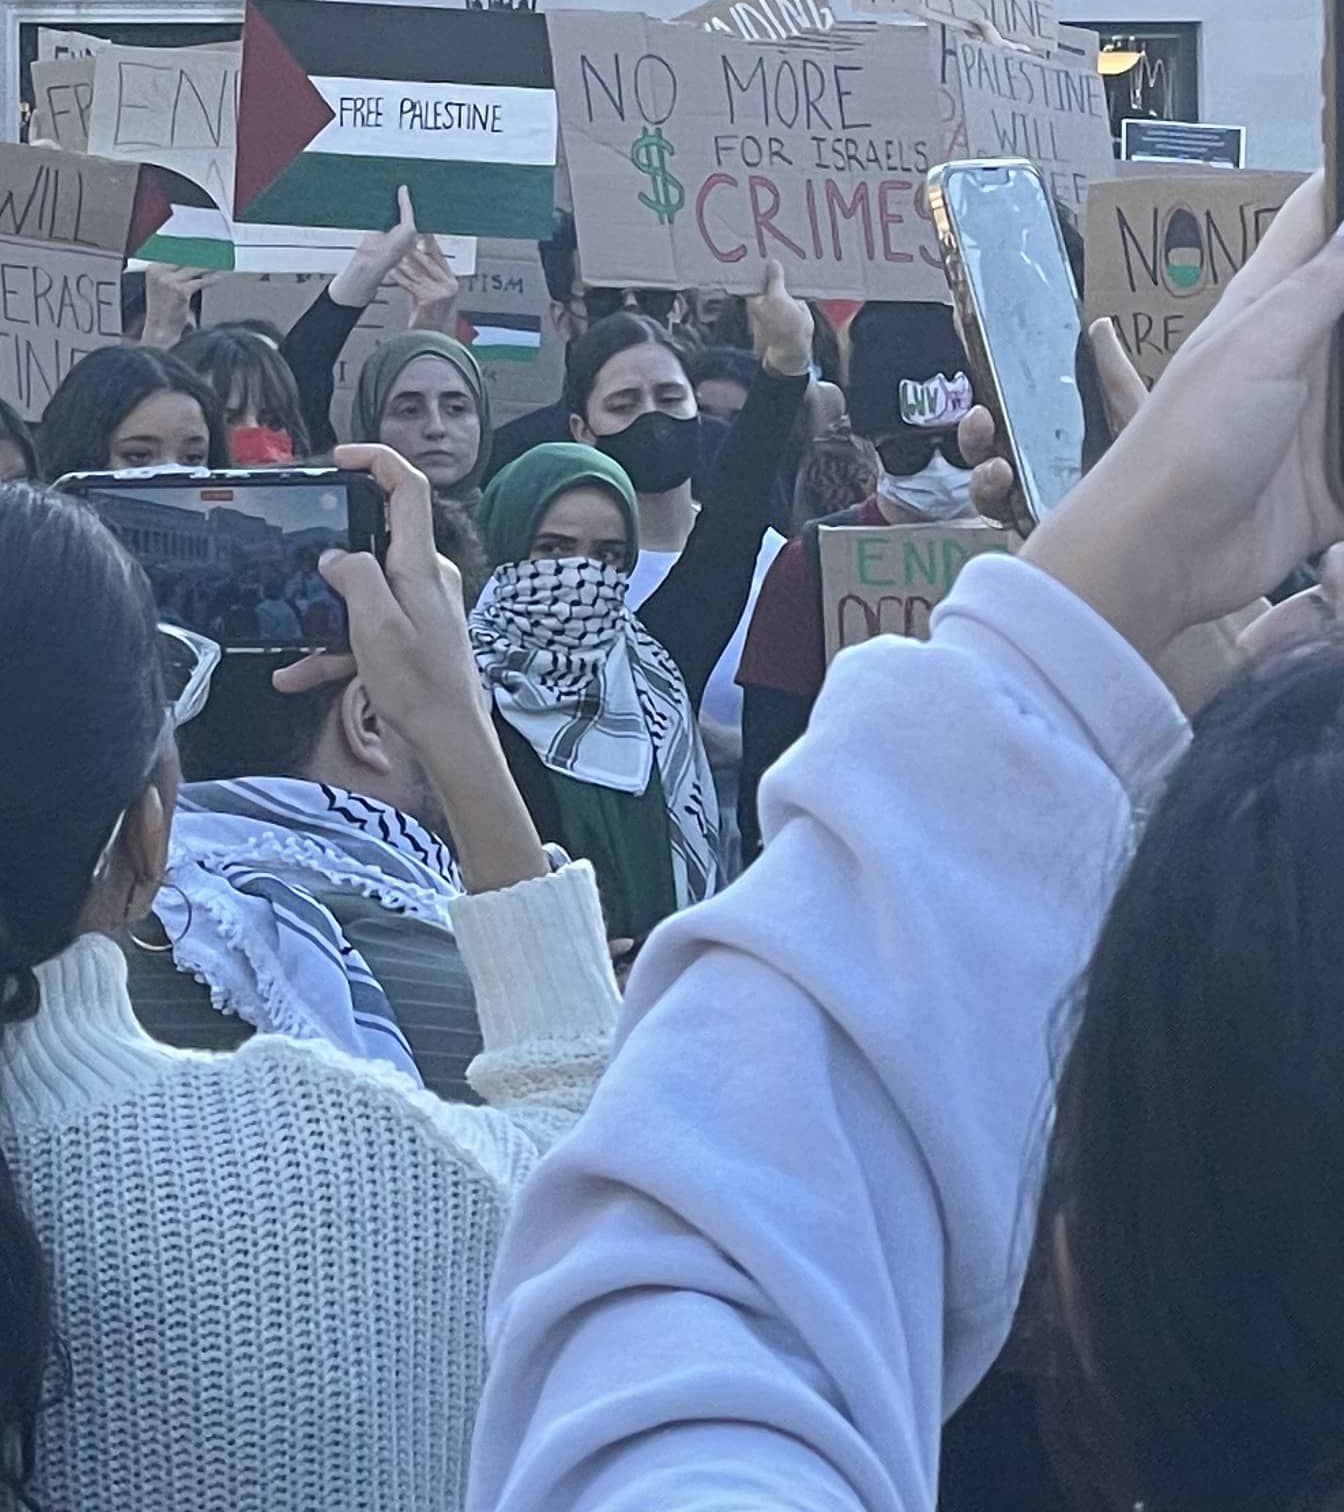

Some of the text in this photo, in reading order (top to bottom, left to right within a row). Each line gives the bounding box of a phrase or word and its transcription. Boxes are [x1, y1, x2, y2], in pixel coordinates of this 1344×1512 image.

[114, 61, 240, 150] EN
[338, 96, 505, 134] FREE PALESTINE
[579, 51, 677, 125] NO
[720, 54, 872, 131] MORE
[961, 43, 1103, 119] PALESTINE
[713, 134, 928, 173] FOR ISRAELS
[0, 262, 123, 338] ERASE
